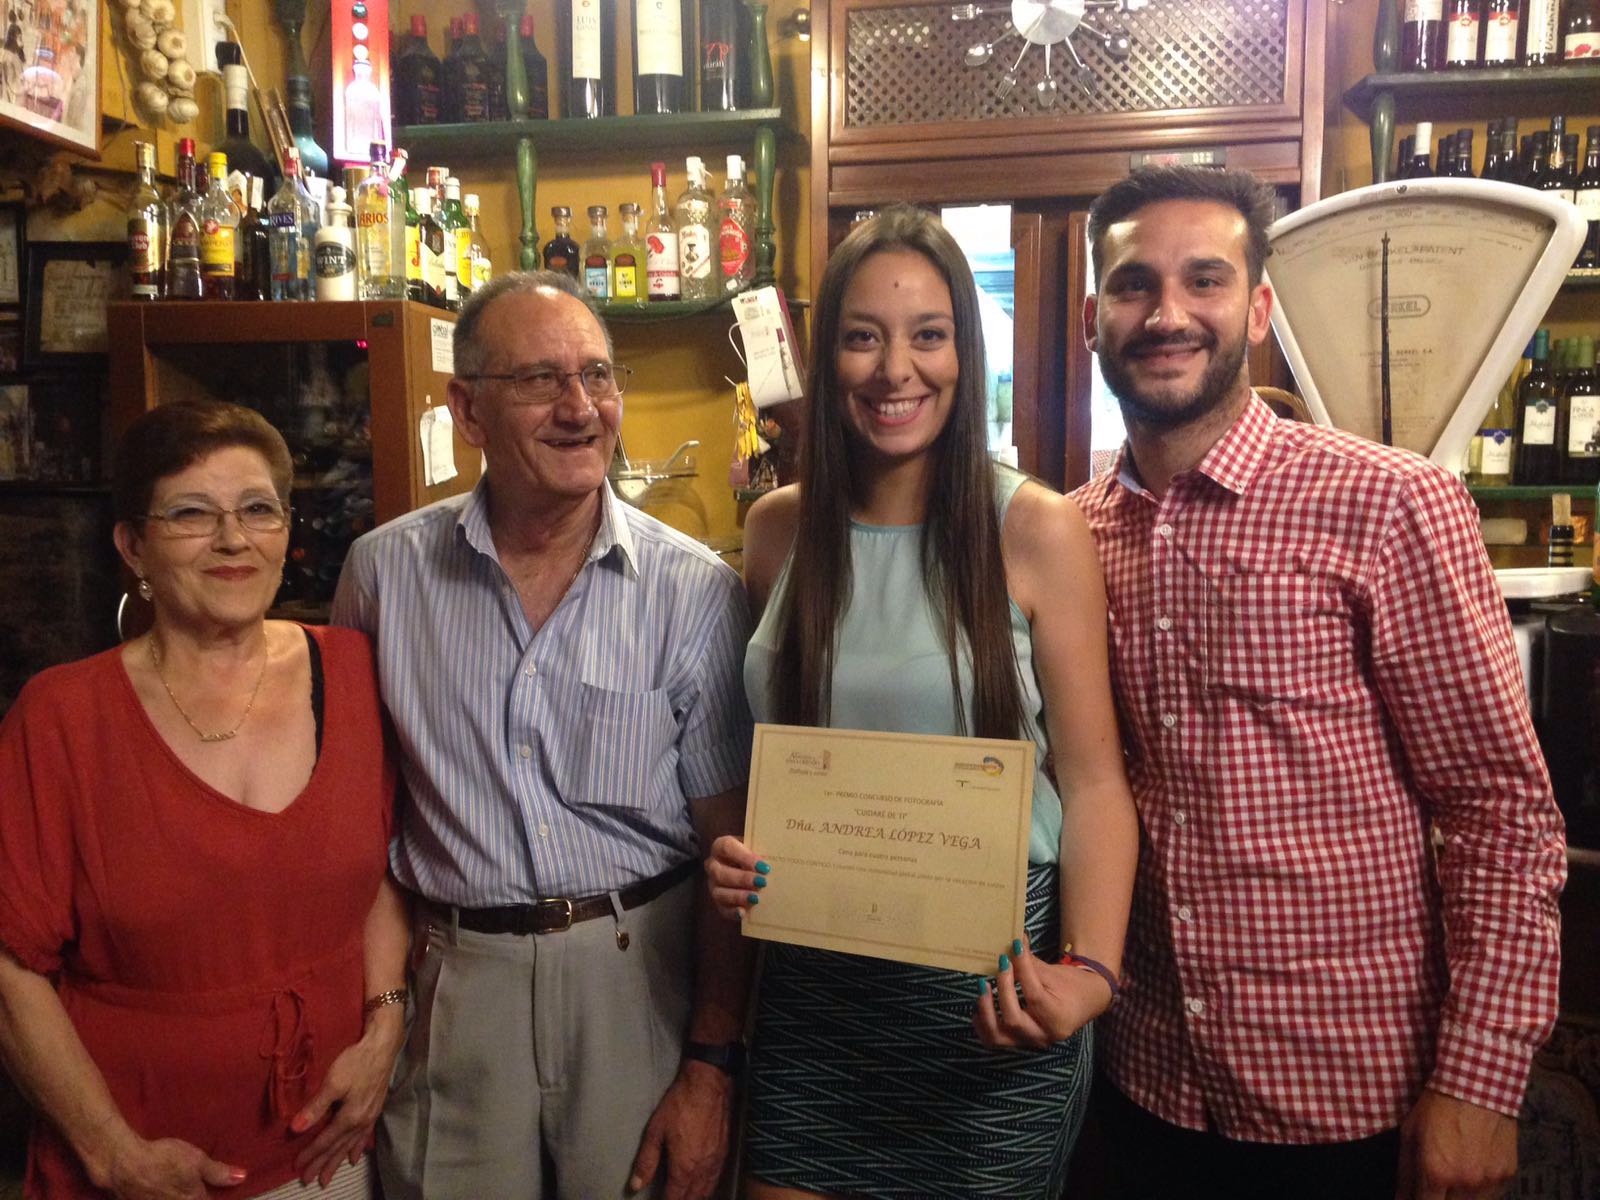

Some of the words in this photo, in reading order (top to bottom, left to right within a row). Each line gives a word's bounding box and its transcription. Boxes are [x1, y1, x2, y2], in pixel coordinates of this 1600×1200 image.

[270, 213, 294, 227] RIVES
[786, 818, 815, 832] Dña.
[818, 821, 884, 840] ANDREA
[888, 827, 936, 845] LÓPEZ
[939, 831, 982, 850] VEGA
